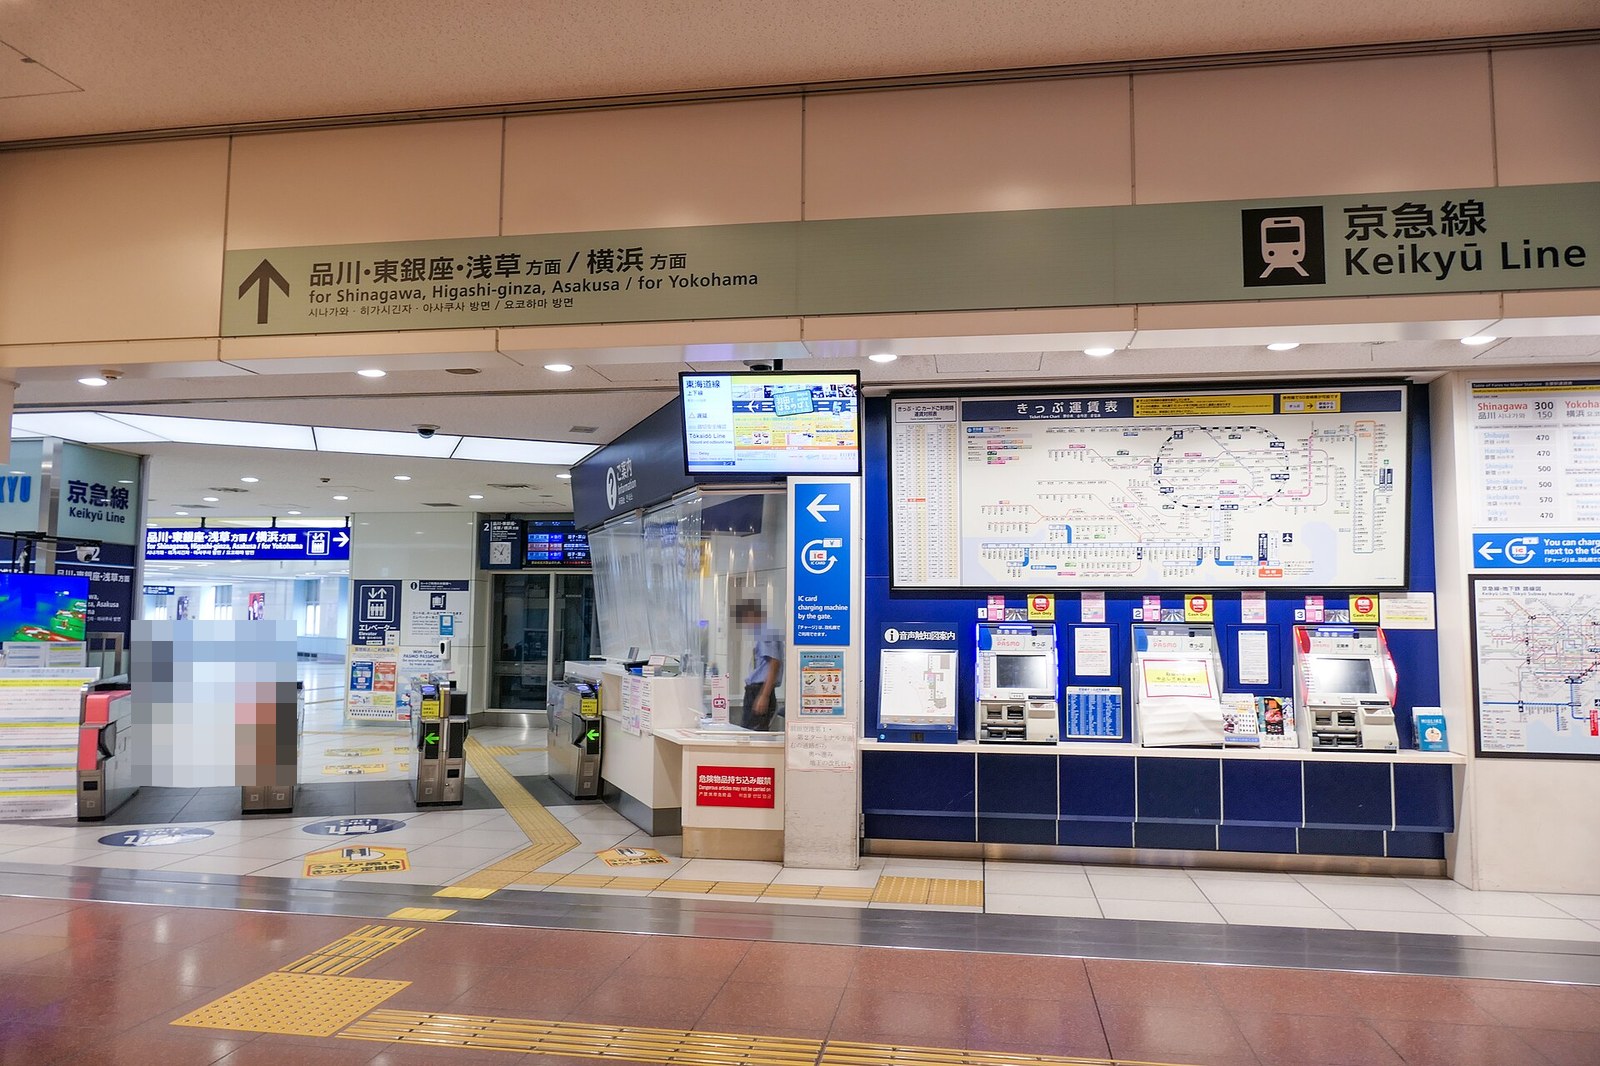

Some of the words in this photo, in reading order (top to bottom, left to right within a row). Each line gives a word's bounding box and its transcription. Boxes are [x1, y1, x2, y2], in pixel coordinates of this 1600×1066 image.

[1343, 199, 1488, 242] 京急線
[1345, 243, 1483, 281] Keikyū
[1501, 239, 1586, 270] Line
[309, 291, 332, 303] for
[337, 288, 426, 304] Shinagawa,
[432, 282, 546, 300] Higashi-ginza,
[552, 278, 619, 293] Asakusa
[638, 275, 663, 290] for
[668, 272, 758, 288] Yokohama
[308, 306, 349, 318] 시나가와
[686, 380, 721, 388] 東海道線
[1017, 400, 1118, 414] きっぷ運賃表
[1477, 402, 1528, 413] Shinagawa
[1534, 401, 1554, 410] 300
[0, 476, 31, 504] YU
[67, 480, 130, 510] 京急線
[69, 506, 103, 523] Keikyū
[105, 511, 126, 524] Line
[484, 522, 490, 532] 2
[1544, 538, 1561, 546] You
[1575, 547, 1589, 555] the
[797, 604, 823, 612] charging
[1134, 609, 1142, 618] 2
[797, 613, 806, 621] by
[817, 613, 833, 621] gate.
[1297, 611, 1304, 619] 3
[358, 624, 397, 632] エレベーター
